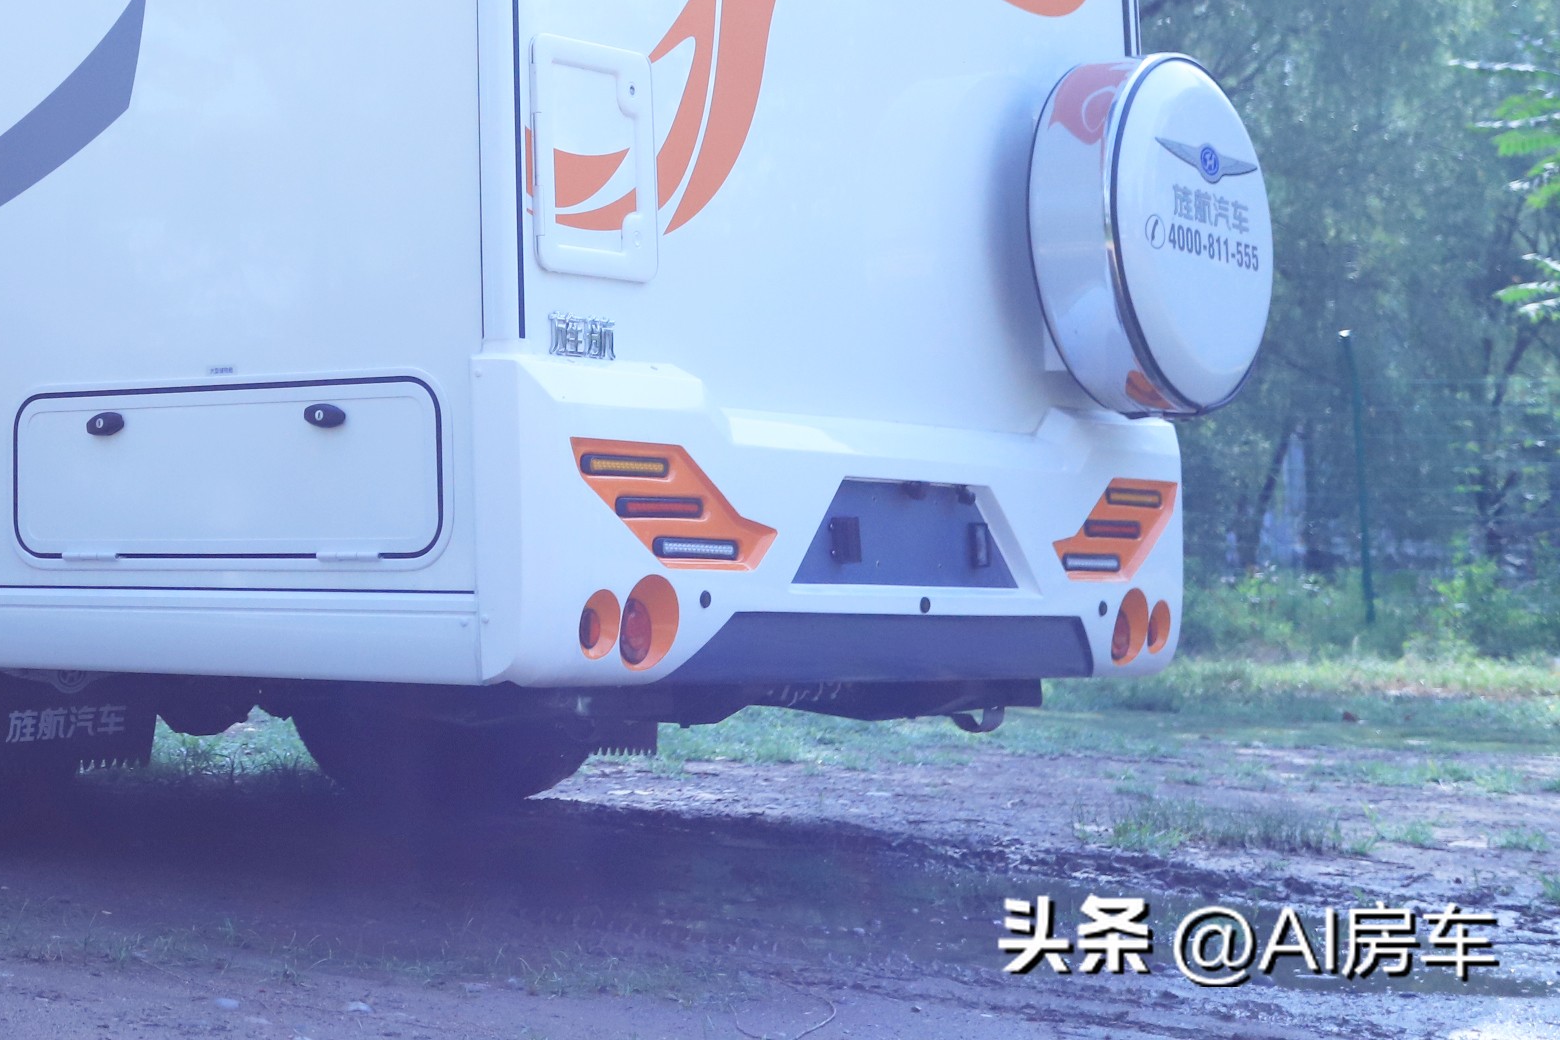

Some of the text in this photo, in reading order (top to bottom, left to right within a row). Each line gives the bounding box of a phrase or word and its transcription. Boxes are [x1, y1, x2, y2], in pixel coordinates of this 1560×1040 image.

[1172, 183, 1250, 235] 旌航汽车
[1168, 222, 1259, 272] 4000-811-555
[5, 703, 127, 744] 旌航汽车
